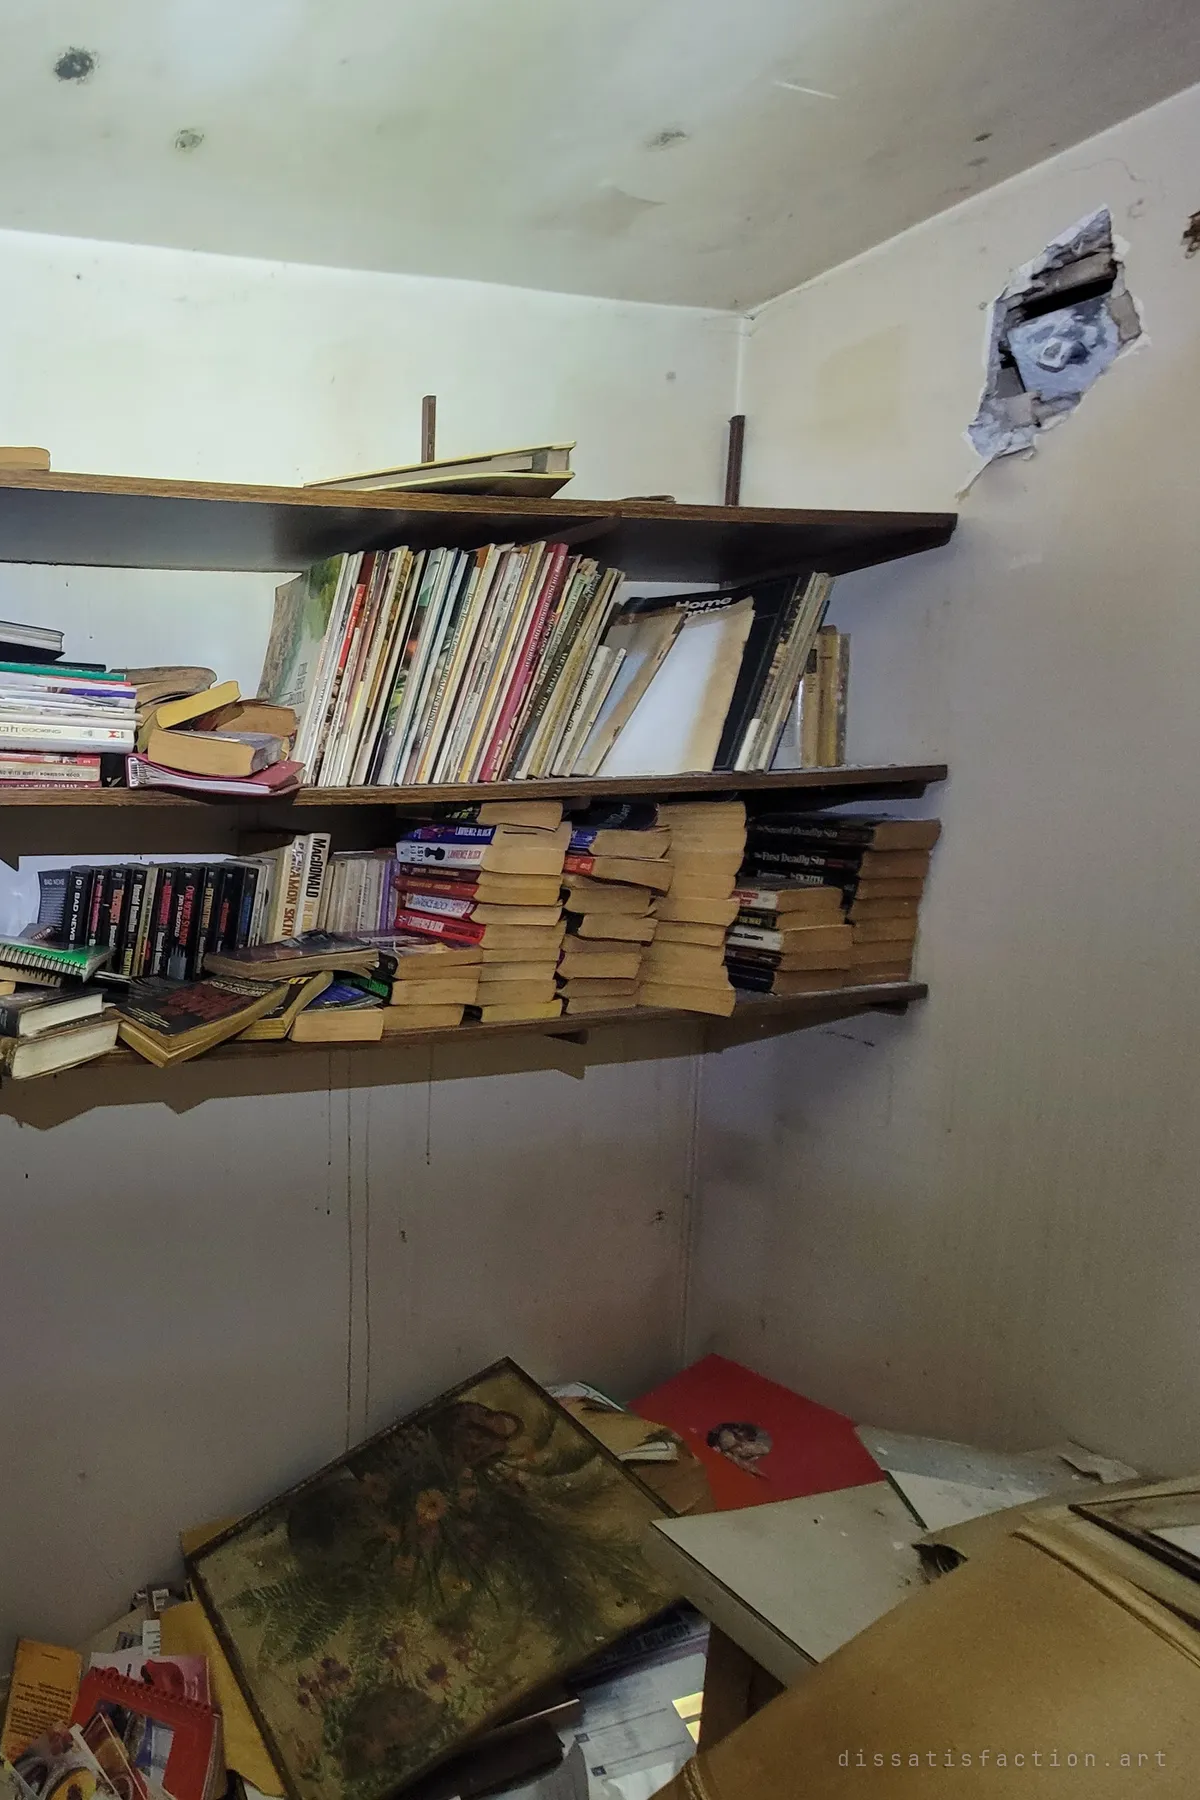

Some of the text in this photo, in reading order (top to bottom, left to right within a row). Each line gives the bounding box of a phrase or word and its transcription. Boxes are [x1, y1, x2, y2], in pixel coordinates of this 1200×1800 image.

[675, 597, 732, 609] Home
[477, 827, 492, 837] BLOCK
[761, 851, 780, 862] First
[184, 885, 195, 901] ONE
[69, 892, 81, 941] BAD NEWS
[280, 907, 295, 936] SKIN
